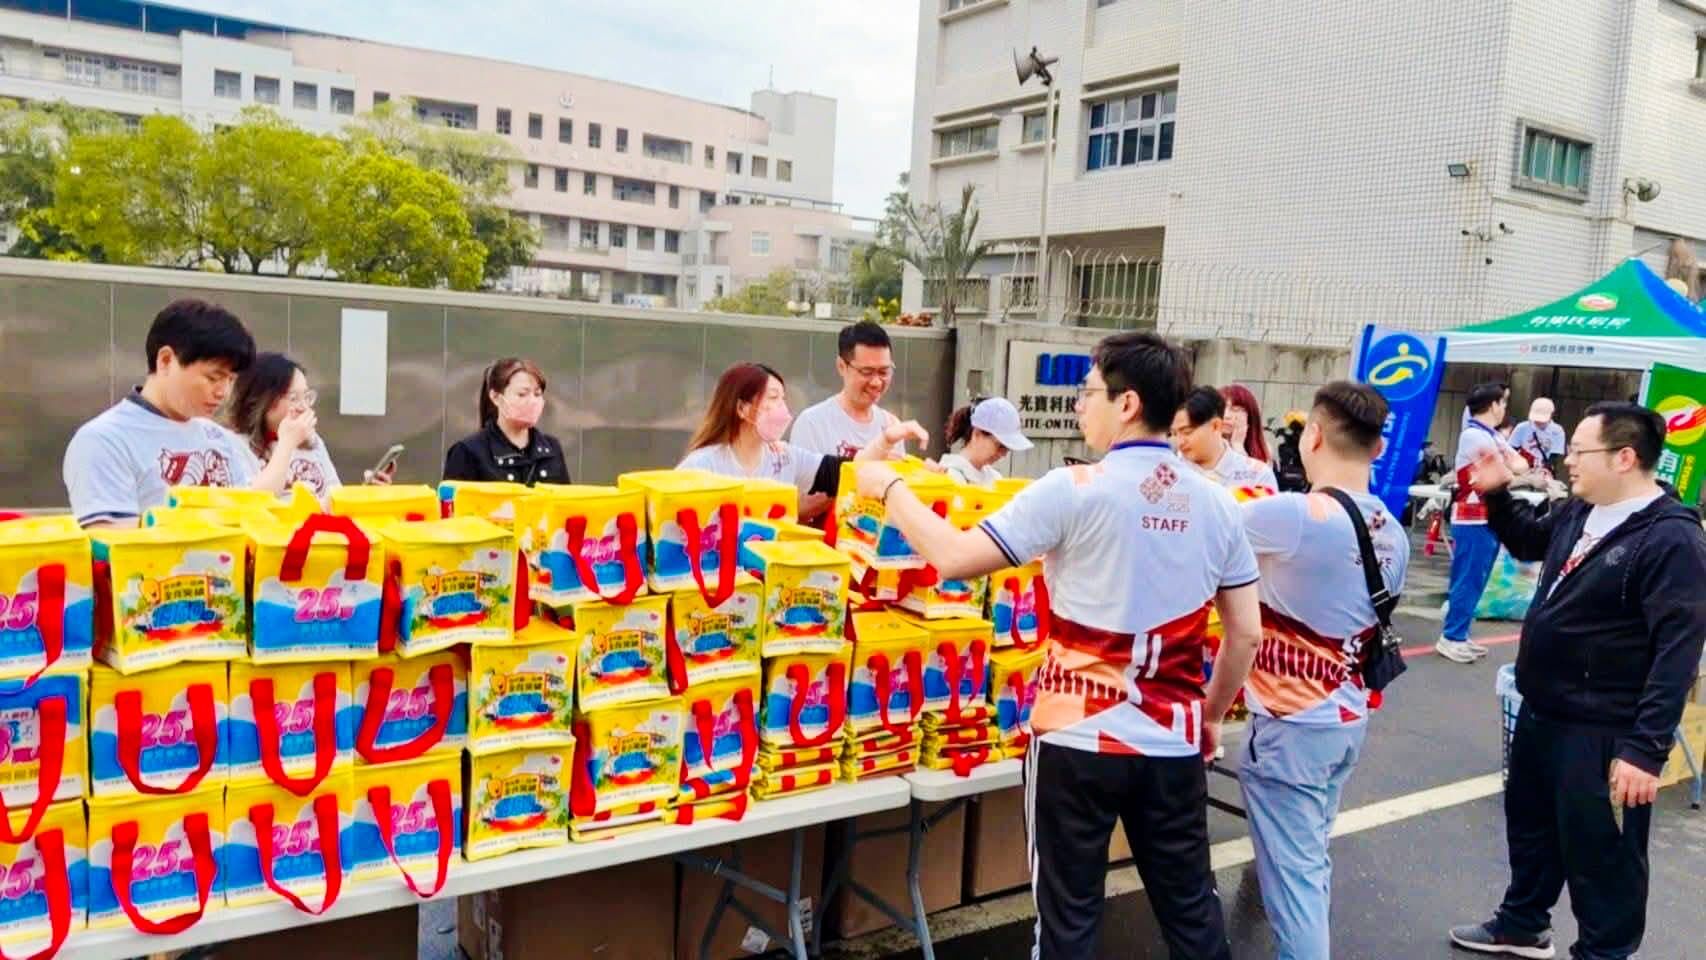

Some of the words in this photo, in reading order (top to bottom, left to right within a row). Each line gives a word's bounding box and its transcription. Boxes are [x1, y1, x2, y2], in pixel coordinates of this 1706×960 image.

[1142, 515, 1189, 532] STAFF
[295, 587, 343, 622] 25
[131, 840, 182, 881] 25
